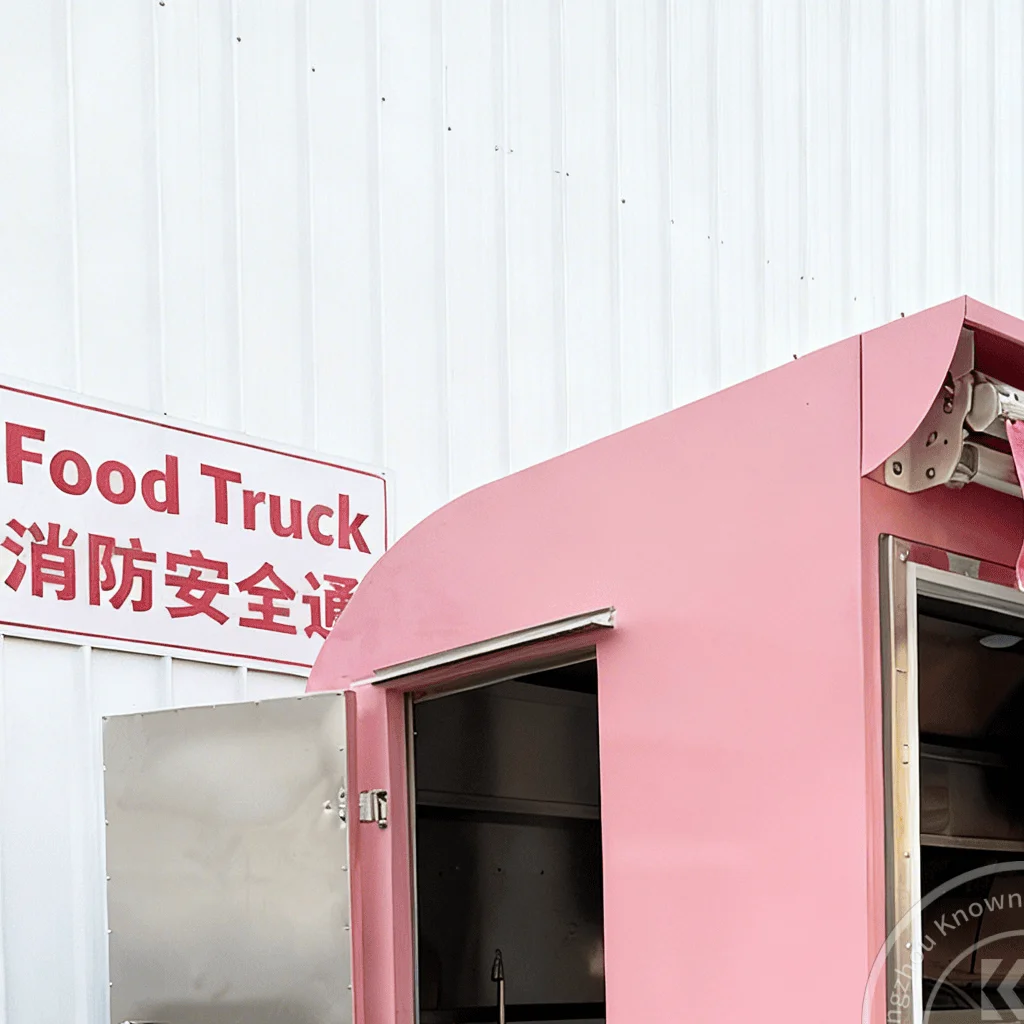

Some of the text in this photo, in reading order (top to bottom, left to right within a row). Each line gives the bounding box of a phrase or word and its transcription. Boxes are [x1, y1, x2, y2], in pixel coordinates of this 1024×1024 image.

[5, 421, 372, 555] Food Truck
[0, 518, 359, 639] 消防安全通
